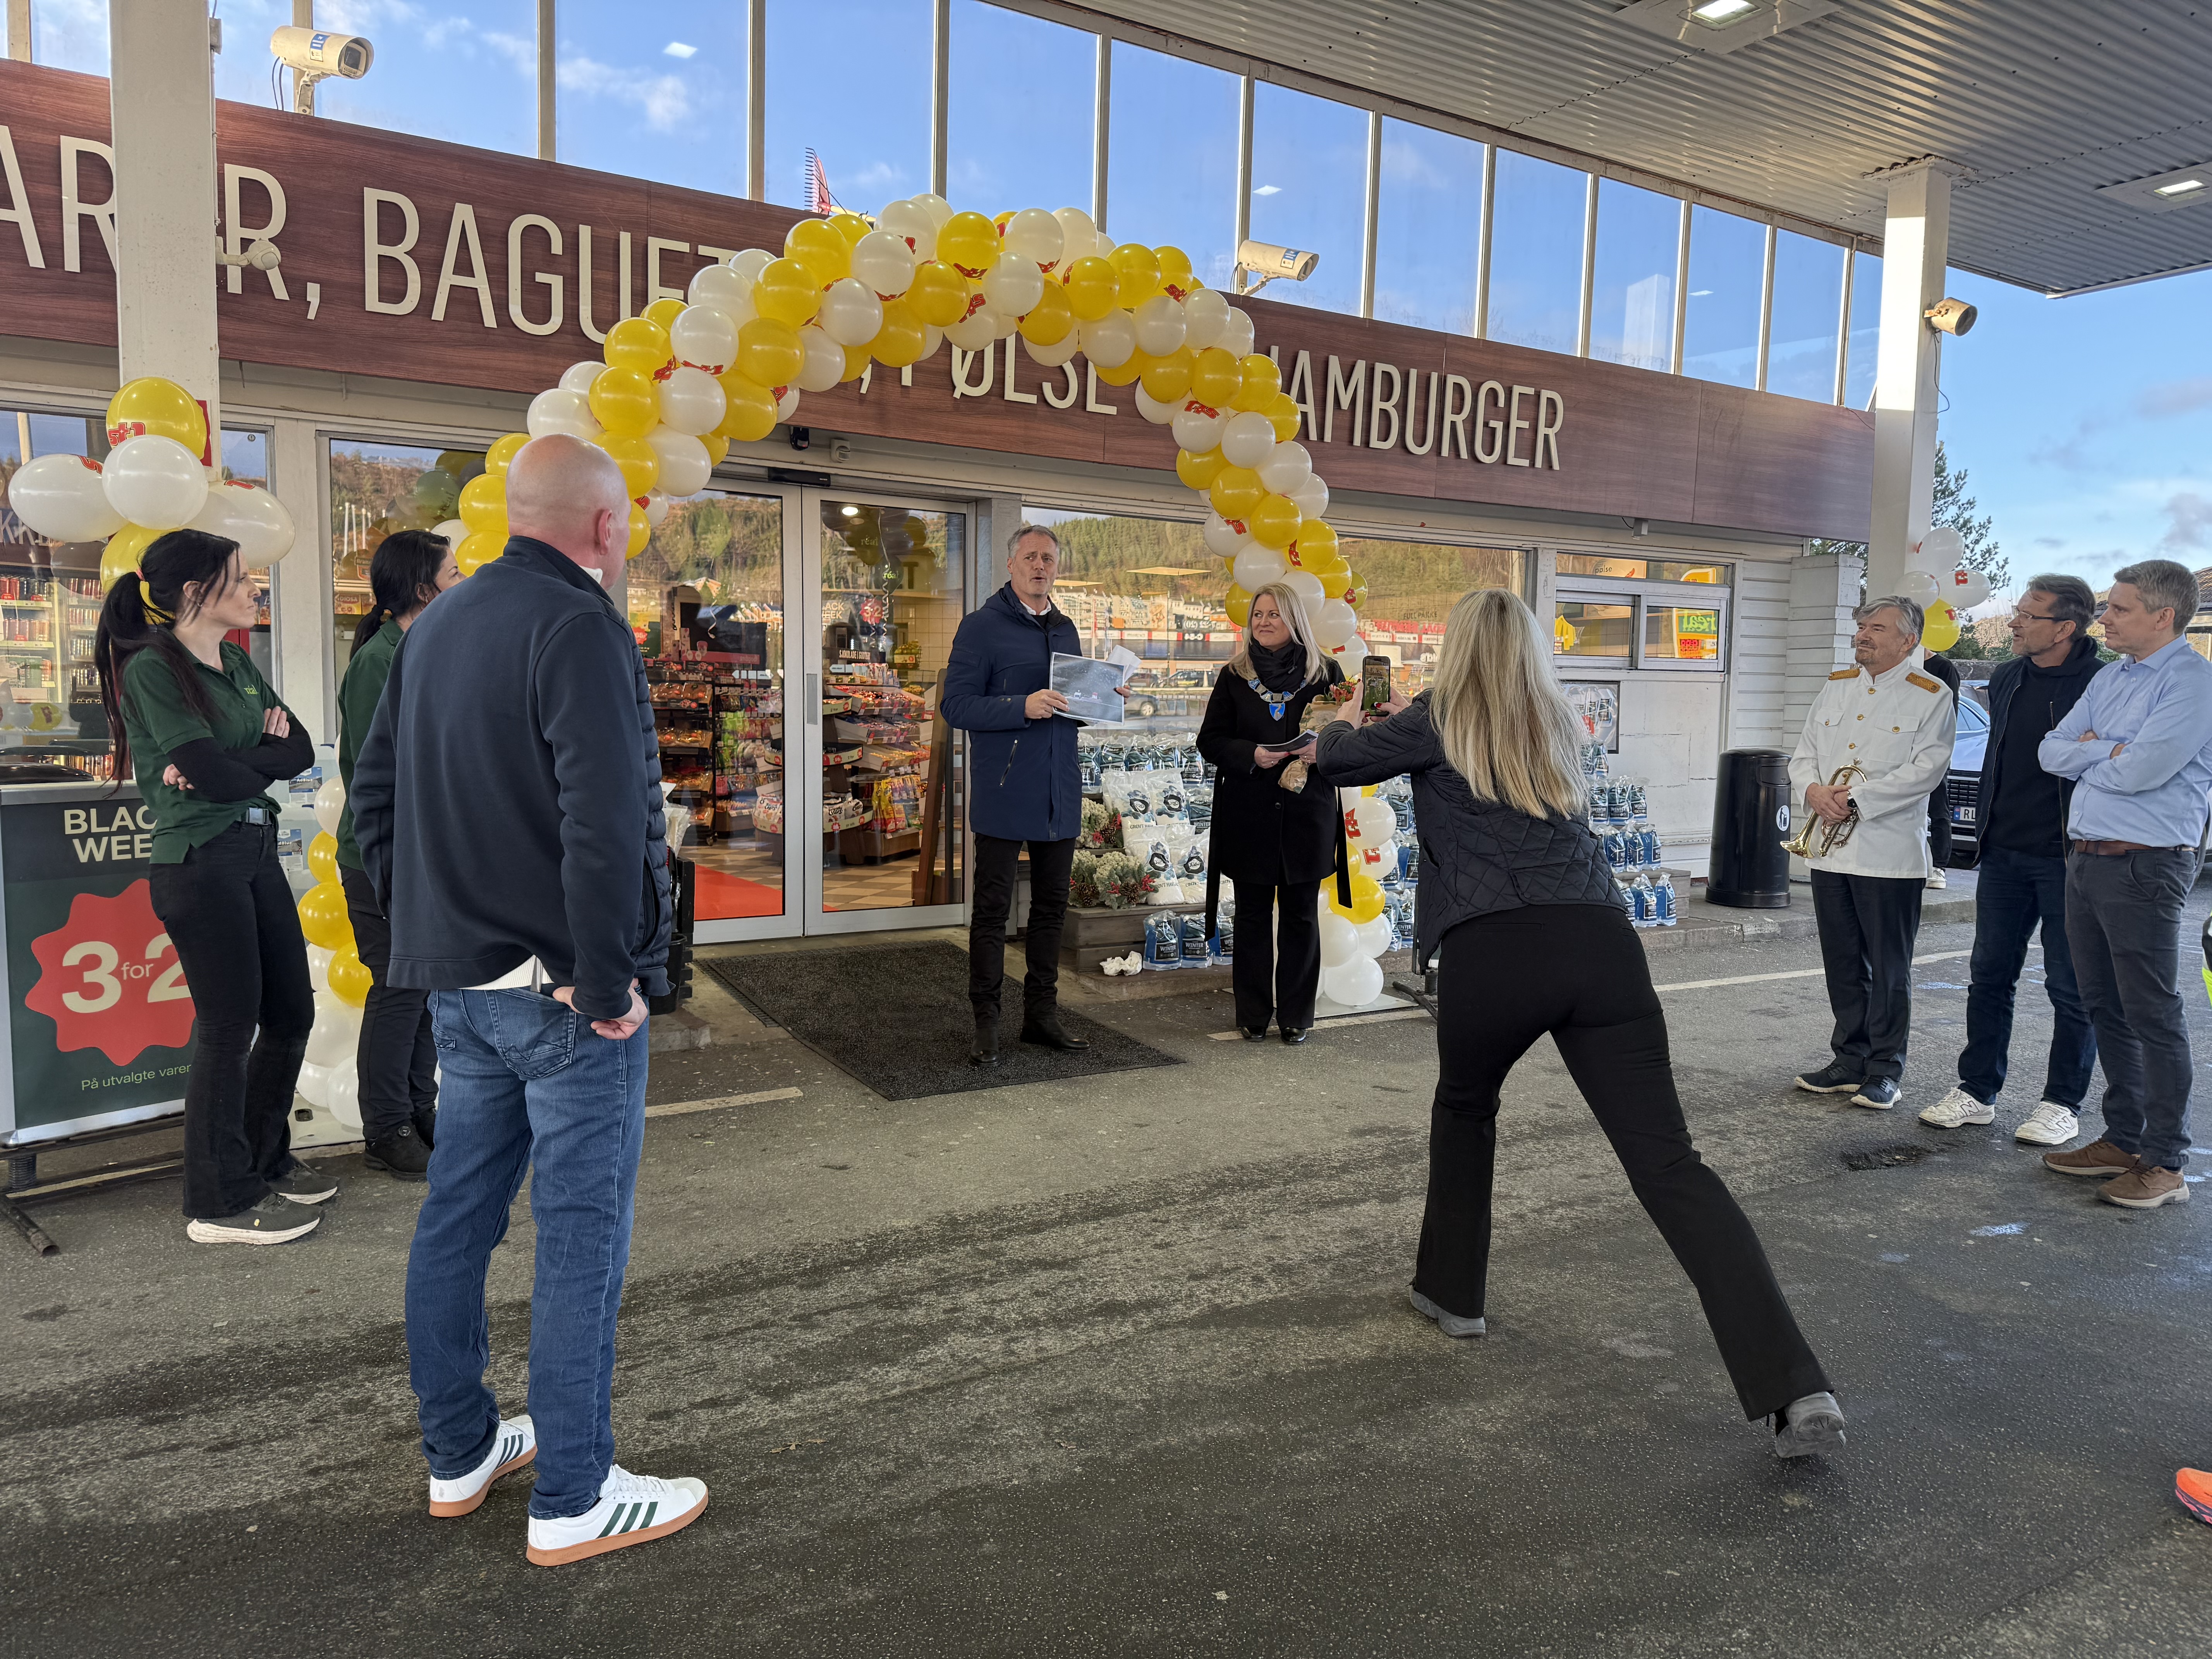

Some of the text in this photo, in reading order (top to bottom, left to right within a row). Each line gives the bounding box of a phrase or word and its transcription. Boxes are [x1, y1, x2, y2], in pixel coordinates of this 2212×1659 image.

[861, 535, 878, 546] réal
[64, 805, 158, 835] BLAC
[72, 834, 153, 863] WEE
[62, 932, 192, 1013] 3 for 2
[81, 1064, 191, 1091] På utvalgte varer
[1960, 1100, 1980, 1117] N
